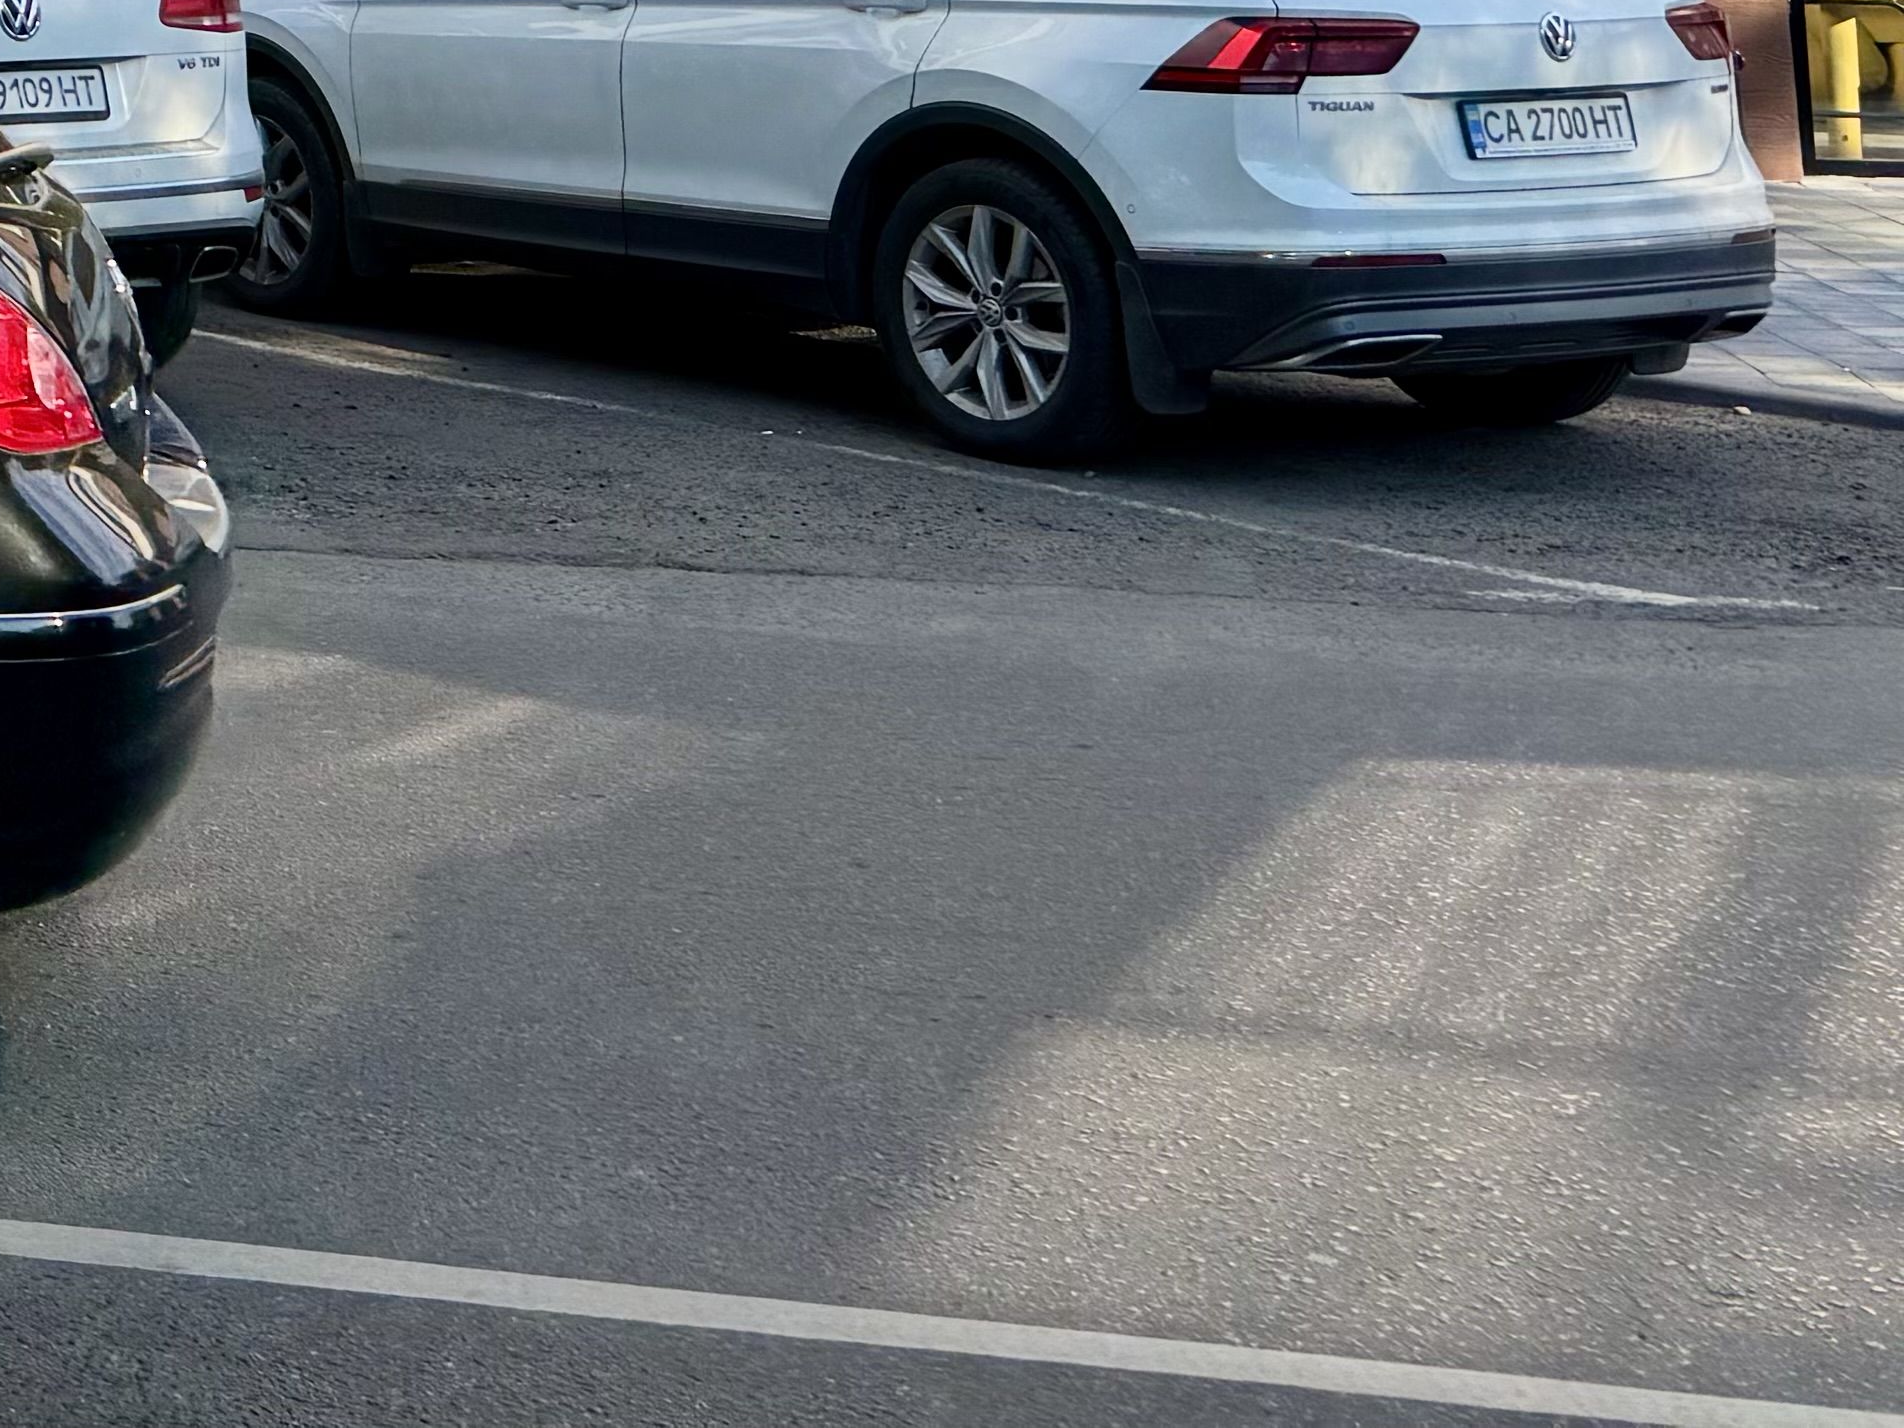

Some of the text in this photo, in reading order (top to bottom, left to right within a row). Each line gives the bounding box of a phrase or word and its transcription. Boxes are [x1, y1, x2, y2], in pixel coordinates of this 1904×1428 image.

[177, 58, 196, 69] V6
[58, 75, 95, 107] HT
[1308, 100, 1375, 113] TIGUAN
[1483, 104, 1624, 144] CA 2700 HT
